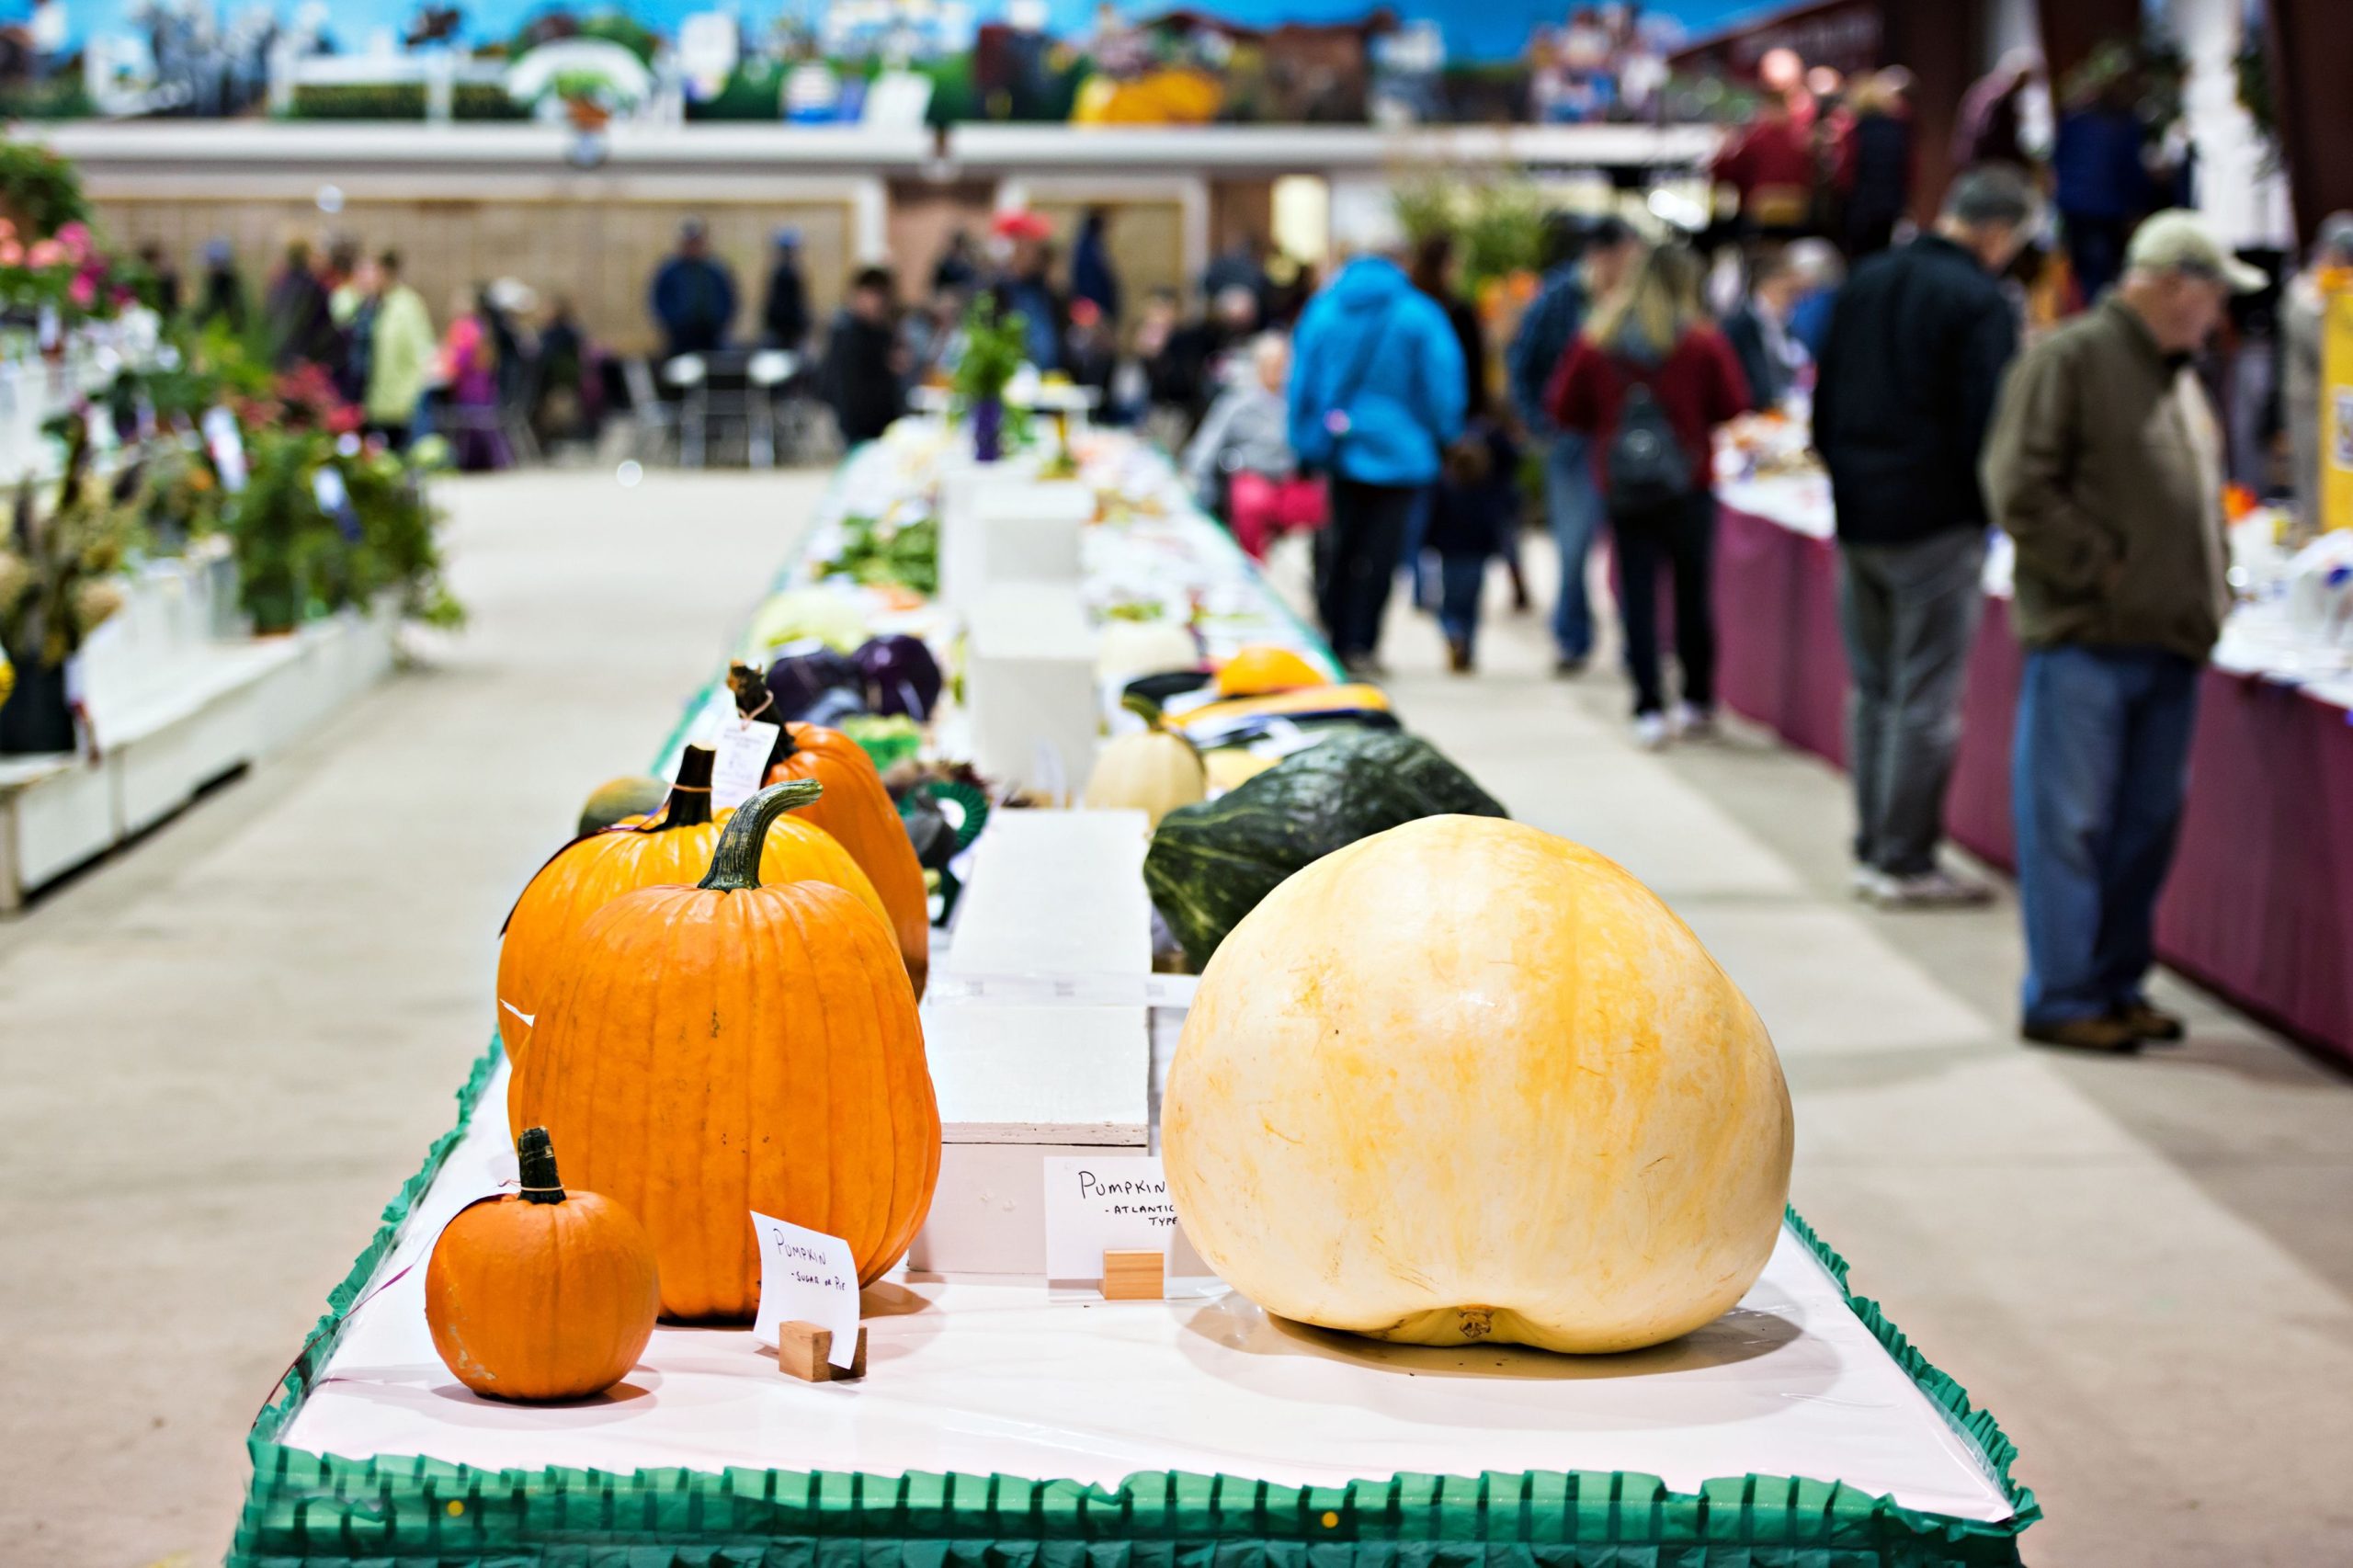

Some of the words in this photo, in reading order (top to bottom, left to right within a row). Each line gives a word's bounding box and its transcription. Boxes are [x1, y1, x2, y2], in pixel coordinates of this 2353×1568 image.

[1078, 1170, 1165, 1199] PUMPKIN
[1149, 1217, 1177, 1226] TYPE
[773, 1228, 826, 1265] PUMPKIN
